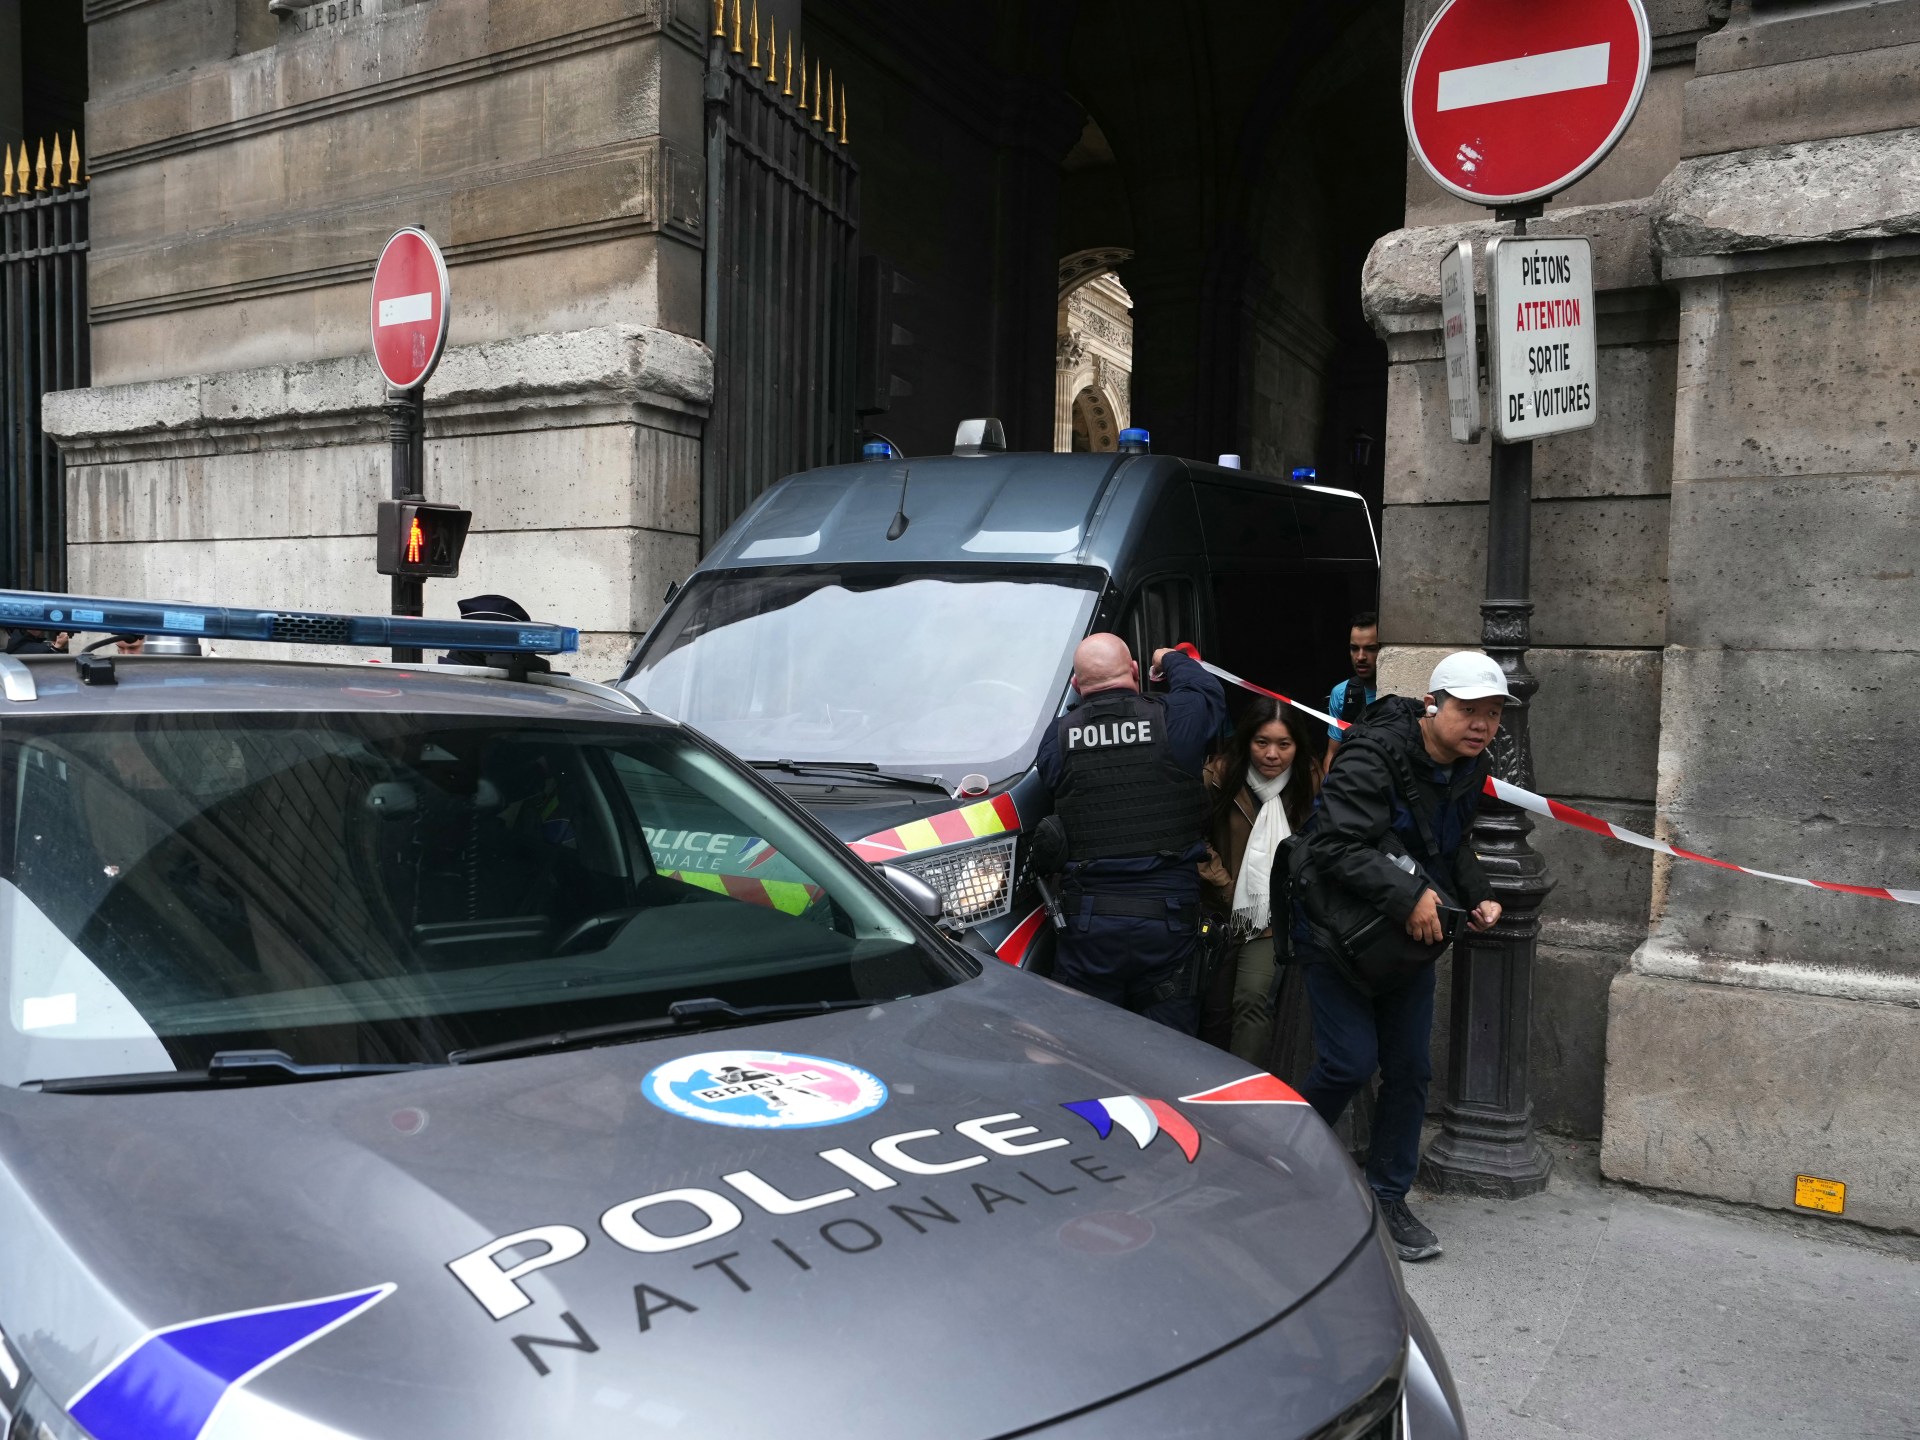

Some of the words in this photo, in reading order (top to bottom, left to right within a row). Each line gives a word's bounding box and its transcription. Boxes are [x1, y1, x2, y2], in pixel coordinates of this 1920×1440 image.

[1522, 249, 1571, 285] PIÉTONS
[1516, 298, 1581, 332] ATTENTION
[1528, 343, 1570, 375] SORTIE
[1509, 392, 1525, 423] DE
[1533, 382, 1591, 418] VOITURES
[1068, 720, 1152, 749] POLICE
[640, 826, 735, 854] OLICE
[650, 852, 722, 870] ONALE
[701, 1073, 822, 1101] BRAV-L
[445, 1112, 1073, 1321] POLICE
[510, 1154, 1127, 1378] NATIONALE
